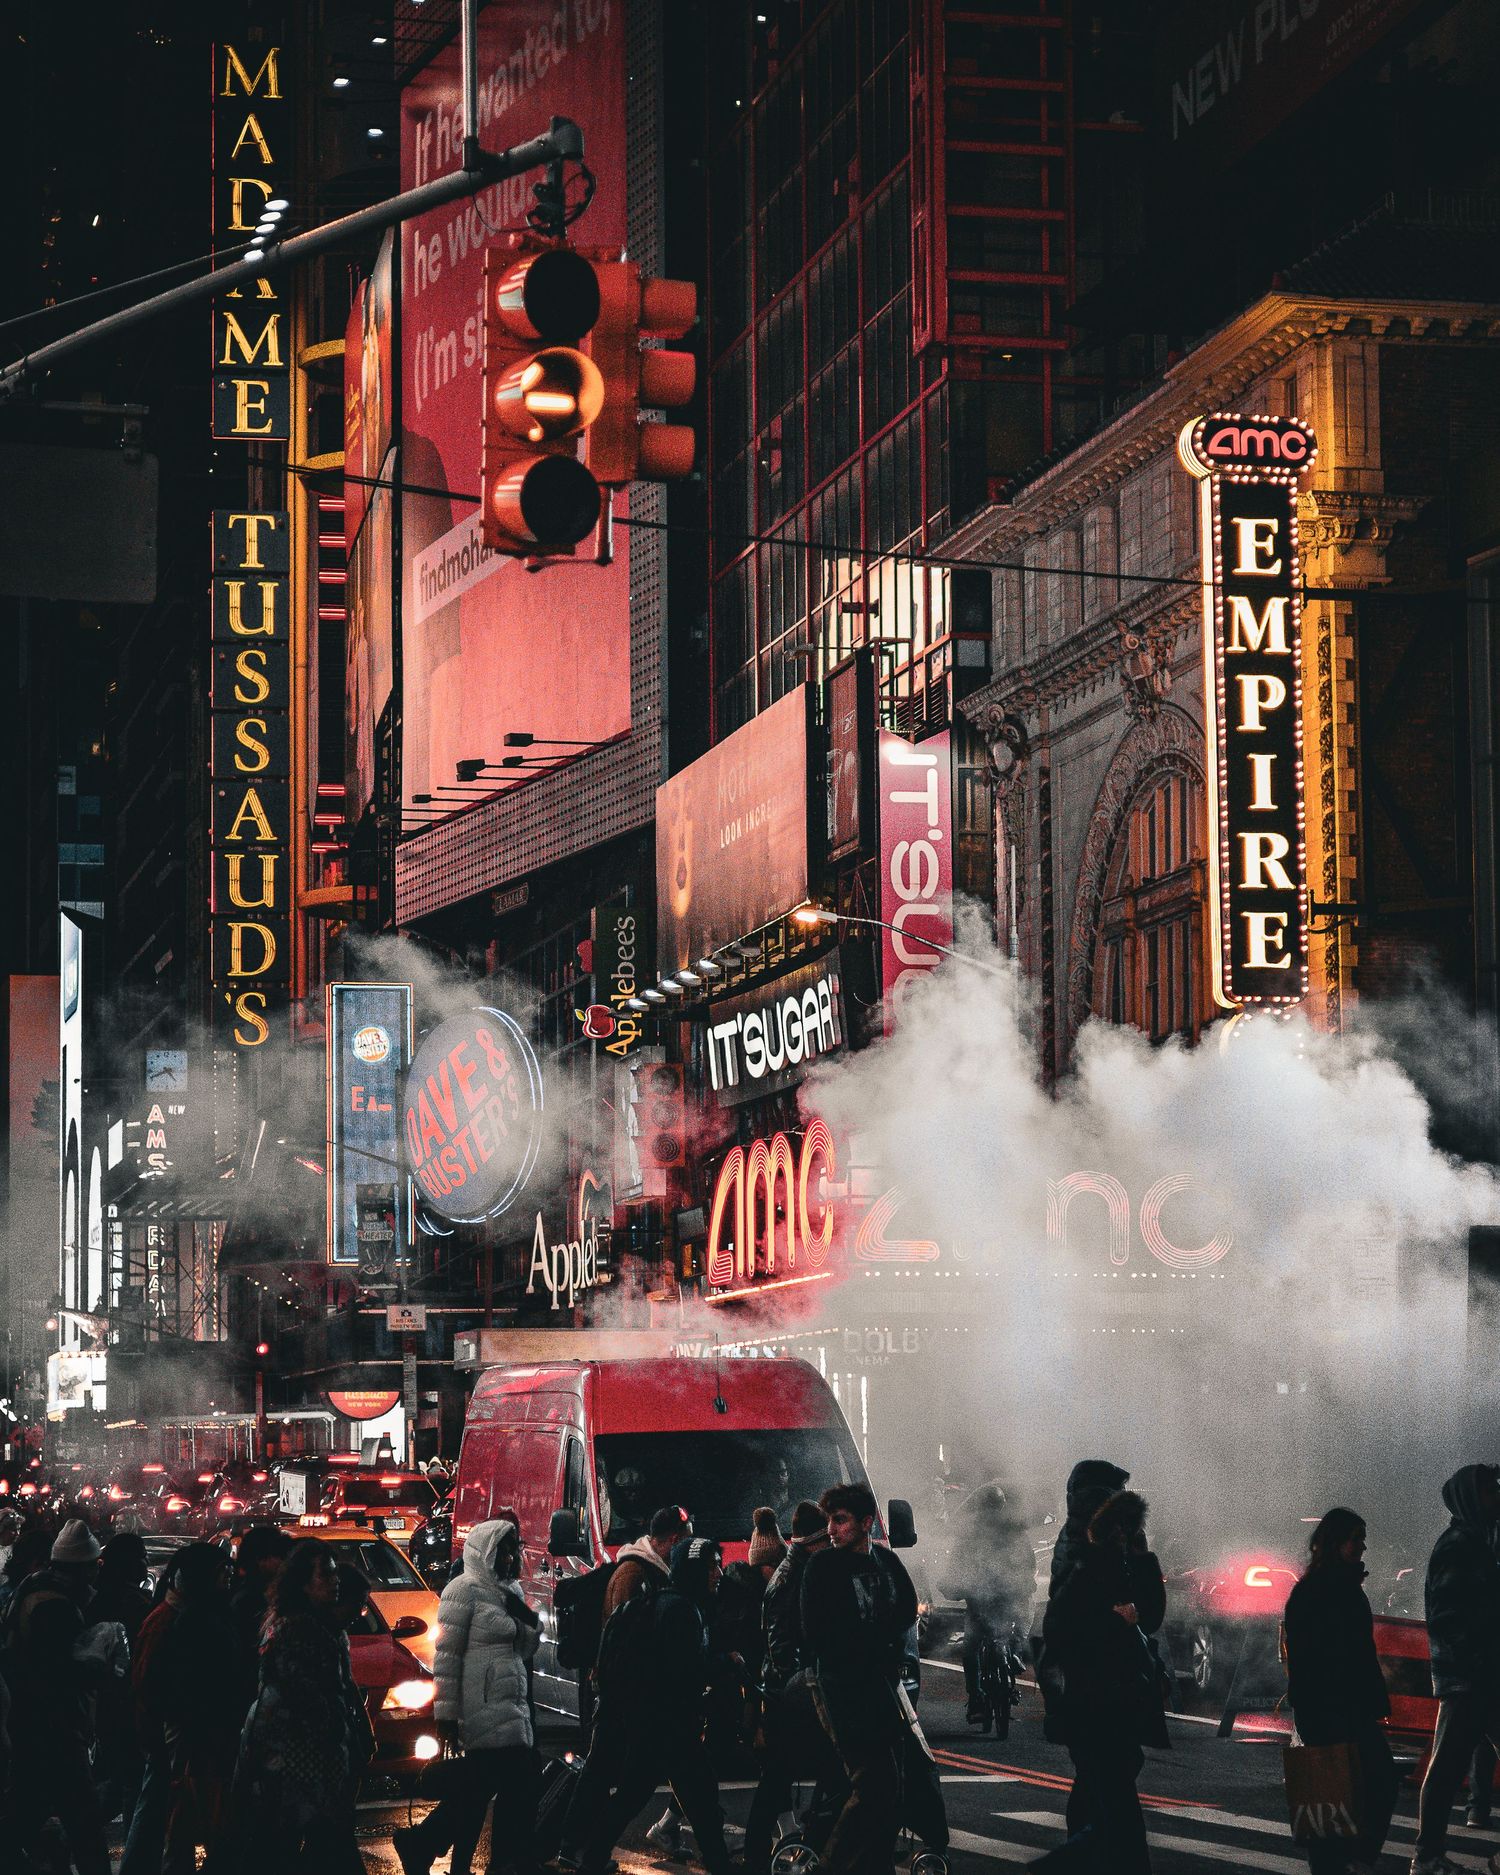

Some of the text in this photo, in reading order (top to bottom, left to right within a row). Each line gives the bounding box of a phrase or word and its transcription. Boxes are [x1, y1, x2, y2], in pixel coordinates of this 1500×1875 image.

[1172, 16, 1246, 141] NEW
[414, 230, 443, 298] he
[219, 43, 285, 1046] MADME TUSSAUD'S
[1224, 515, 1295, 970] EMPIRE
[719, 817, 743, 849] LOOK
[406, 1028, 511, 1169] DAVE &
[419, 1075, 521, 1198] BUSTER'S
